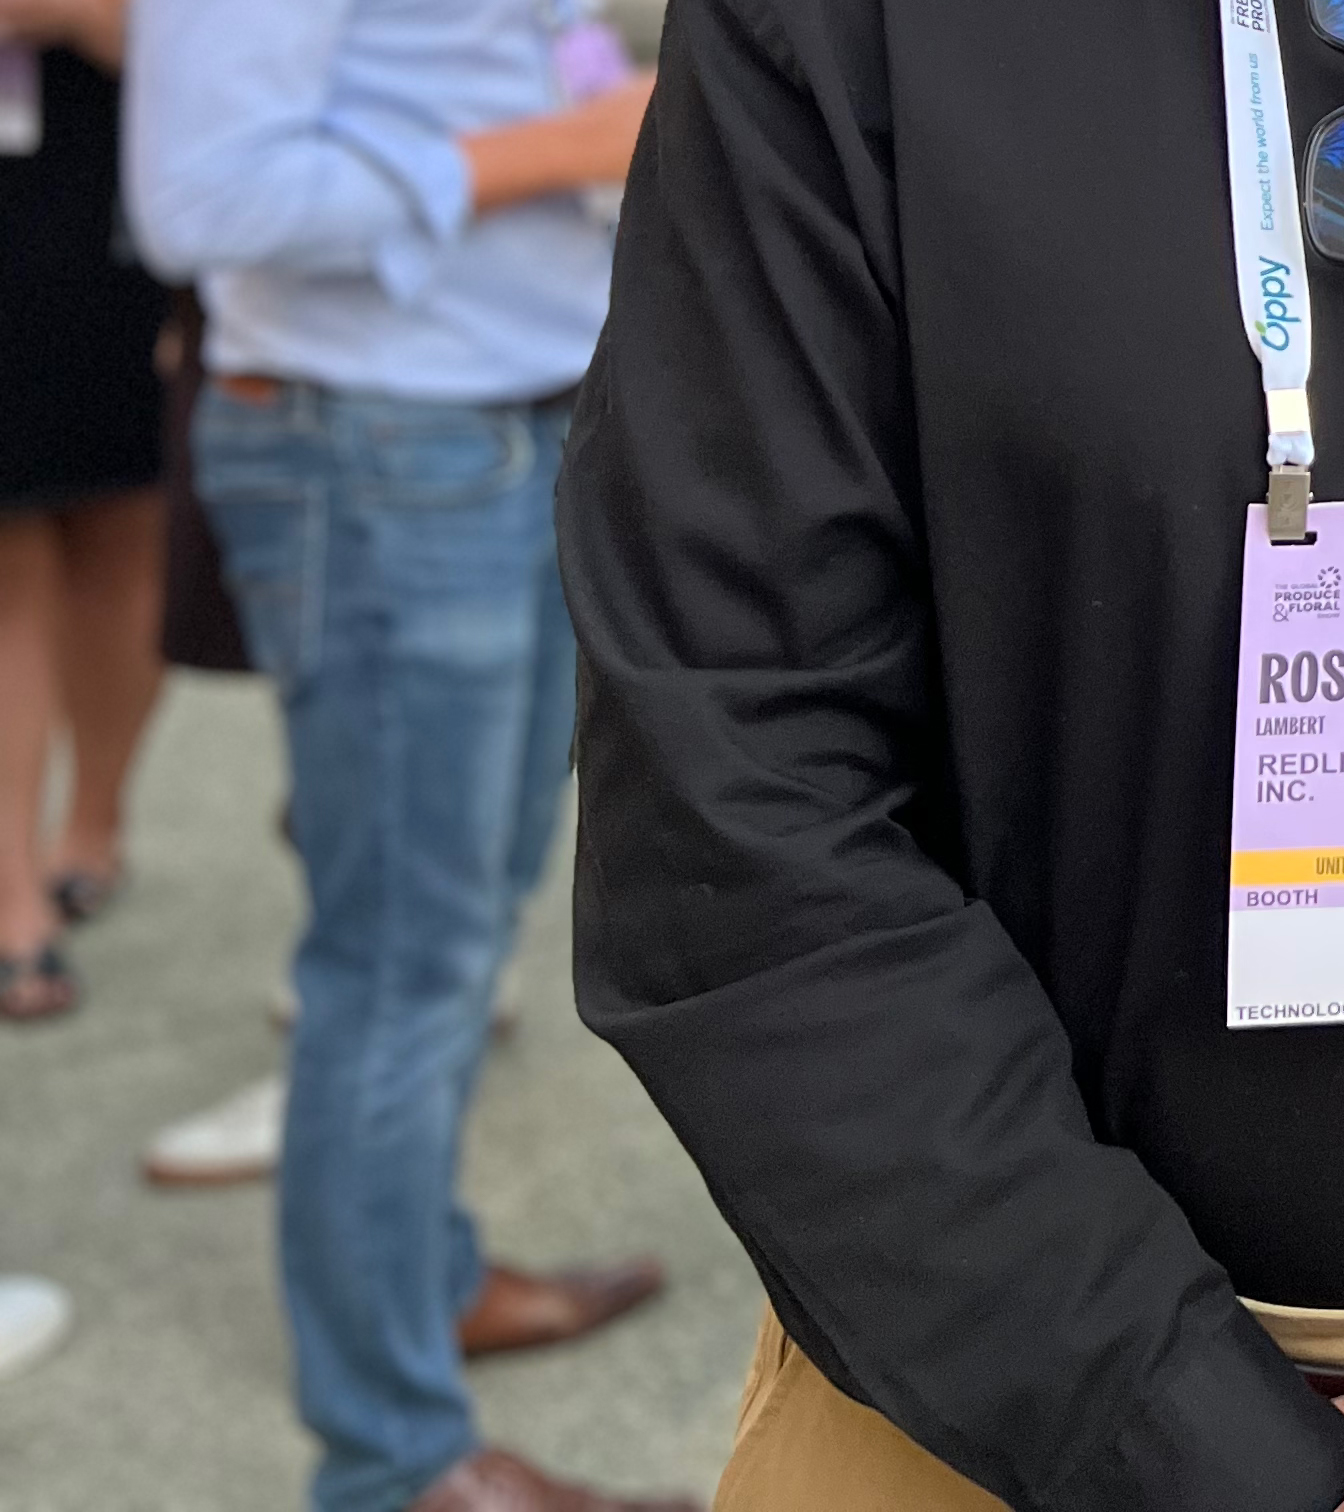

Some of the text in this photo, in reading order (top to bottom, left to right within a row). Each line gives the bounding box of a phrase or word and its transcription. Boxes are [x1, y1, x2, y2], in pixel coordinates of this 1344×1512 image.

[1249, 53, 1275, 231] Expect the world from us
[1259, 255, 1302, 351] Oppy
[1275, 589, 1340, 601] PRODUCE
[1289, 601, 1340, 612] FLORAL
[1256, 715, 1326, 737] LAMBERT
[1257, 779, 1315, 803] INC.
[1246, 889, 1319, 907] BOOTH
